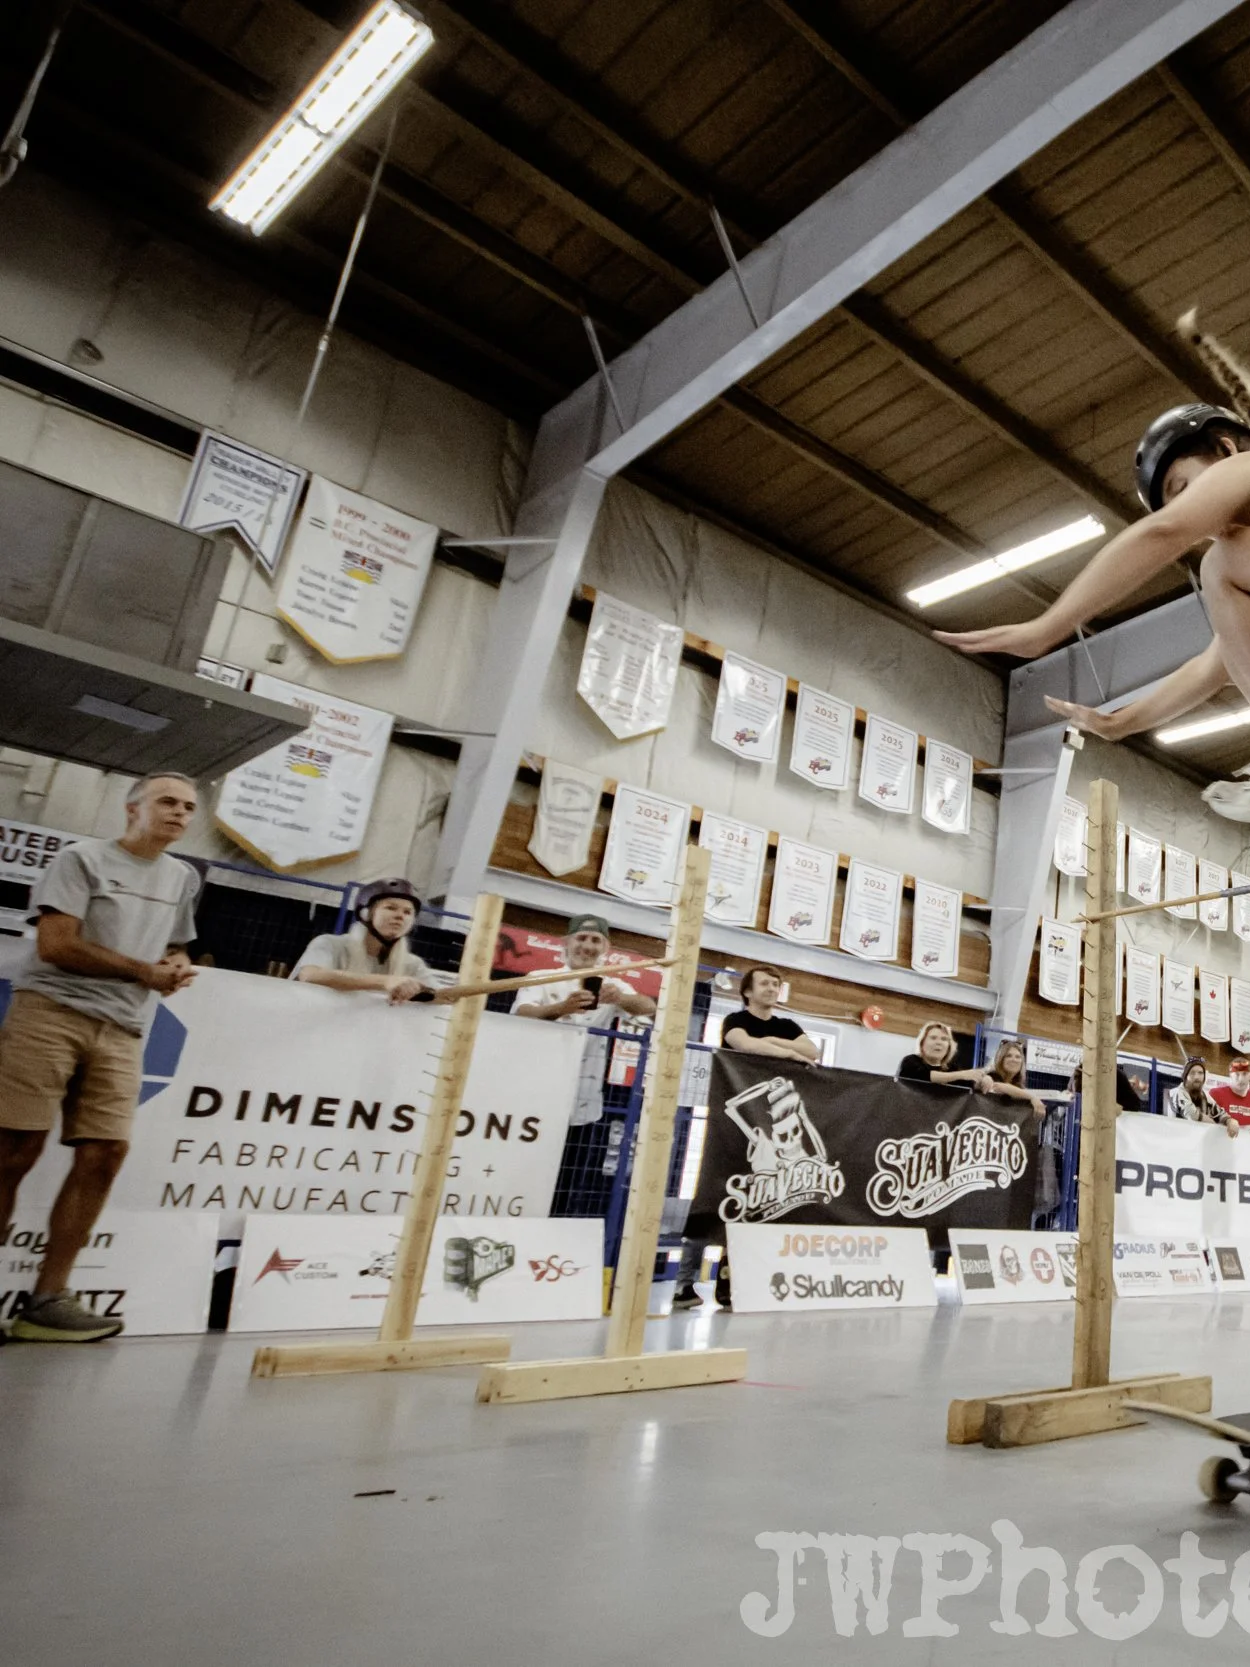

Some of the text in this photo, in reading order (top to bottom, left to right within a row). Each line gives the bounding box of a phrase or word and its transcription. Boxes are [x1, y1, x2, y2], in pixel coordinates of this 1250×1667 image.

[813, 705, 840, 724] 2025
[880, 733, 905, 750] 2025
[635, 804, 669, 825] 2024
[794, 856, 821, 874] 2023
[184, 1085, 542, 1143] DIMENSONS
[171, 1138, 461, 1178] FABRICATIG
[160, 1181, 525, 1217] MANUFACTRING
[778, 1233, 888, 1259] JOECORP
[294, 1271, 338, 1281] CUSTOM
[792, 1273, 905, 1302] Skullcandy
